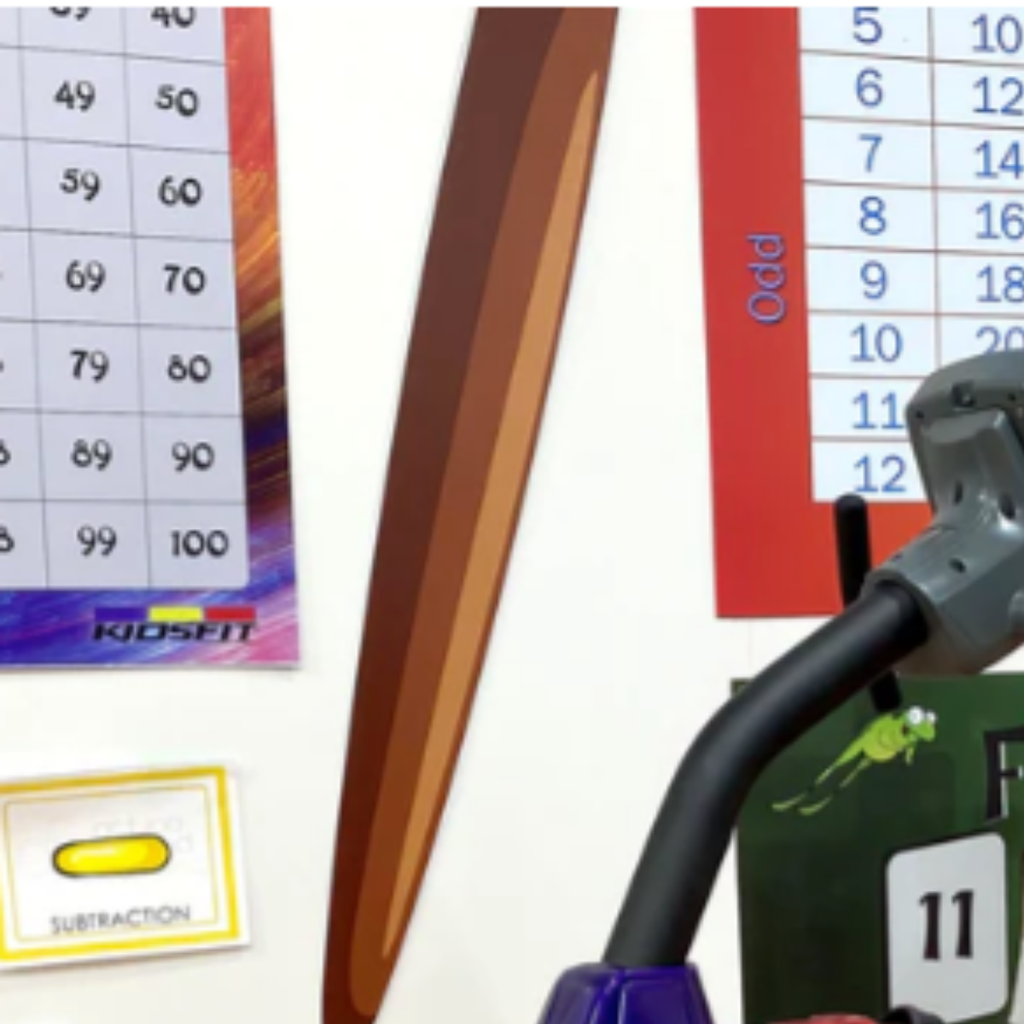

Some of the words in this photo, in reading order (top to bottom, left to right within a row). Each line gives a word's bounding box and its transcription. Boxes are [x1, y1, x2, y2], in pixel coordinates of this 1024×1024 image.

[853, 8, 883, 45] 5
[972, 14, 1023, 54] 10
[54, 80, 96, 111] 49
[155, 85, 198, 118] 50
[856, 67, 883, 108] 6
[973, 76, 1024, 116] 12
[859, 134, 883, 172] 7
[975, 140, 1024, 179] 14
[60, 168, 101, 202] 59
[158, 176, 203, 207] 60
[859, 196, 887, 236] 8
[65, 261, 106, 293] 69
[163, 265, 206, 296] 70
[746, 233, 788, 324] Odd
[860, 260, 888, 300] 9
[852, 323, 903, 363] 10
[70, 350, 110, 383] 79
[167, 354, 212, 384] 80
[852, 392, 906, 430] 11
[71, 440, 113, 471] 89
[172, 442, 215, 472] 90
[853, 454, 907, 494] 12
[77, 527, 118, 557] 99
[170, 530, 230, 558] 100
[50, 904, 191, 935] SUBTRACTION
[919, 889, 974, 961] 11
